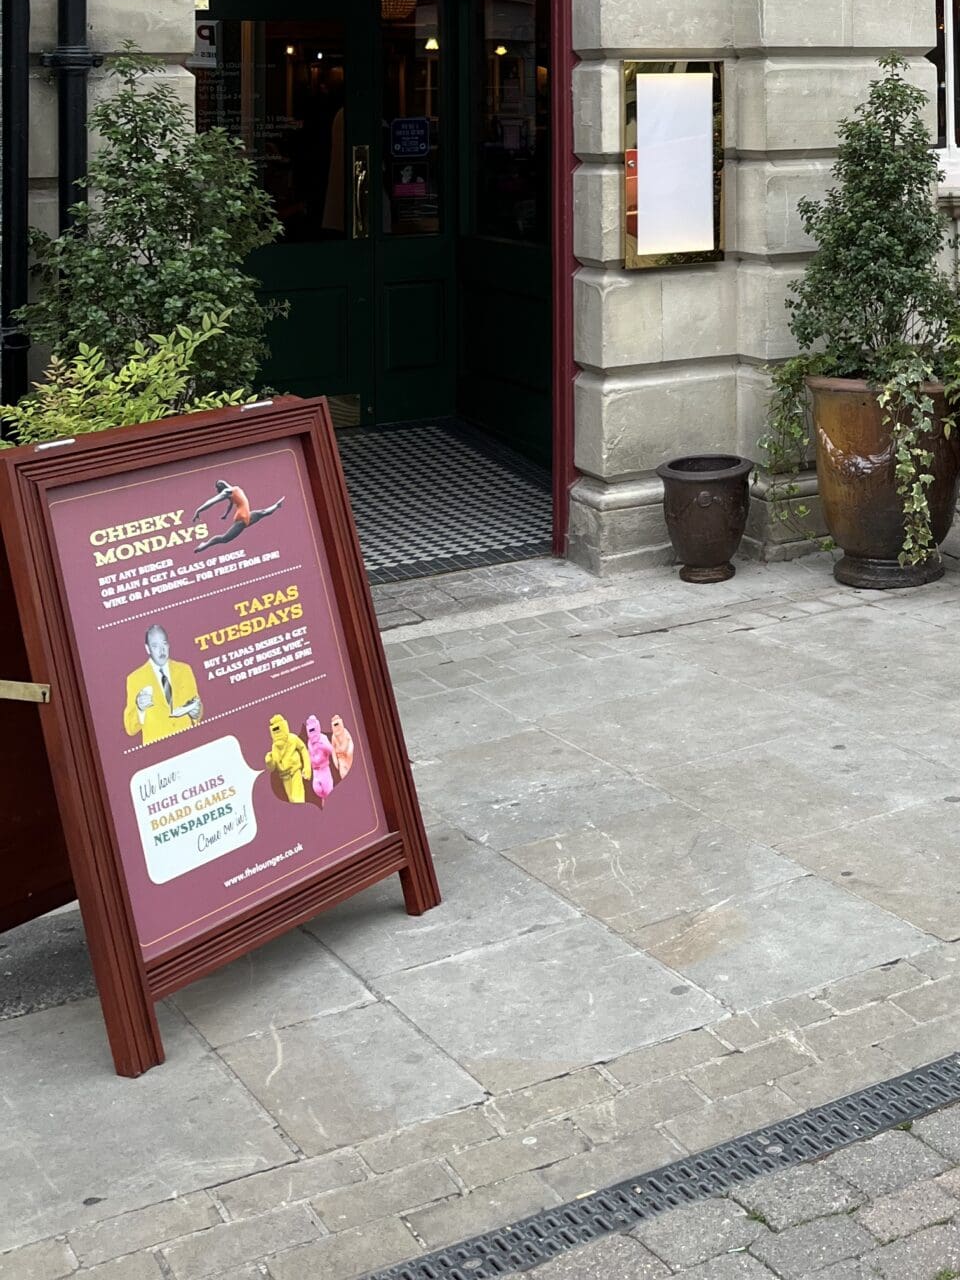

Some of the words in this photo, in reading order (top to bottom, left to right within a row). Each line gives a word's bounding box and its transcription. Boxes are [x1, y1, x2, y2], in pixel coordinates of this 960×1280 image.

[89, 509, 185, 546] CHEEKY
[93, 523, 209, 567] MONDAYS
[98, 572, 117, 586] BUY
[119, 568, 138, 581] ANY
[139, 558, 174, 576] BURGER
[101, 587, 114, 598] OR
[116, 581, 140, 595] MAIN
[149, 572, 168, 585] GET
[169, 570, 177, 578] A
[177, 560, 204, 576] GLASS
[206, 557, 217, 568] OF
[218, 549, 246, 564] HOUSE
[103, 596, 128, 609] WINE
[129, 591, 142, 602] OR
[143, 588, 151, 598] A
[196, 570, 213, 582] FOR
[214, 562, 238, 577] FREE!
[238, 557, 261, 571] FROM
[234, 585, 299, 617] TAPAS
[194, 603, 304, 651] TUESDAYS
[203, 654, 221, 669] BUY
[228, 645, 255, 661] TAPAS
[255, 634, 284, 651] DISHES
[292, 626, 308, 639] GET
[208, 671, 215, 681] A
[215, 661, 243, 678] GLASS
[243, 656, 255, 667] OF
[256, 646, 282, 663] HOUSE
[229, 670, 248, 684] FOR
[248, 663, 271, 678] FREE!
[271, 655, 294, 669] FROM
[139, 777, 156, 802] We
[147, 793, 179, 816] HIGH
[181, 774, 225, 801] CHAIRS
[149, 805, 192, 832] BOARD
[194, 785, 237, 811] GAMES
[153, 803, 234, 847] NEWSPAPERS
[197, 832, 221, 853] Come
[223, 822, 235, 837] on
[223, 842, 304, 888] www.thelounges.co.uk
